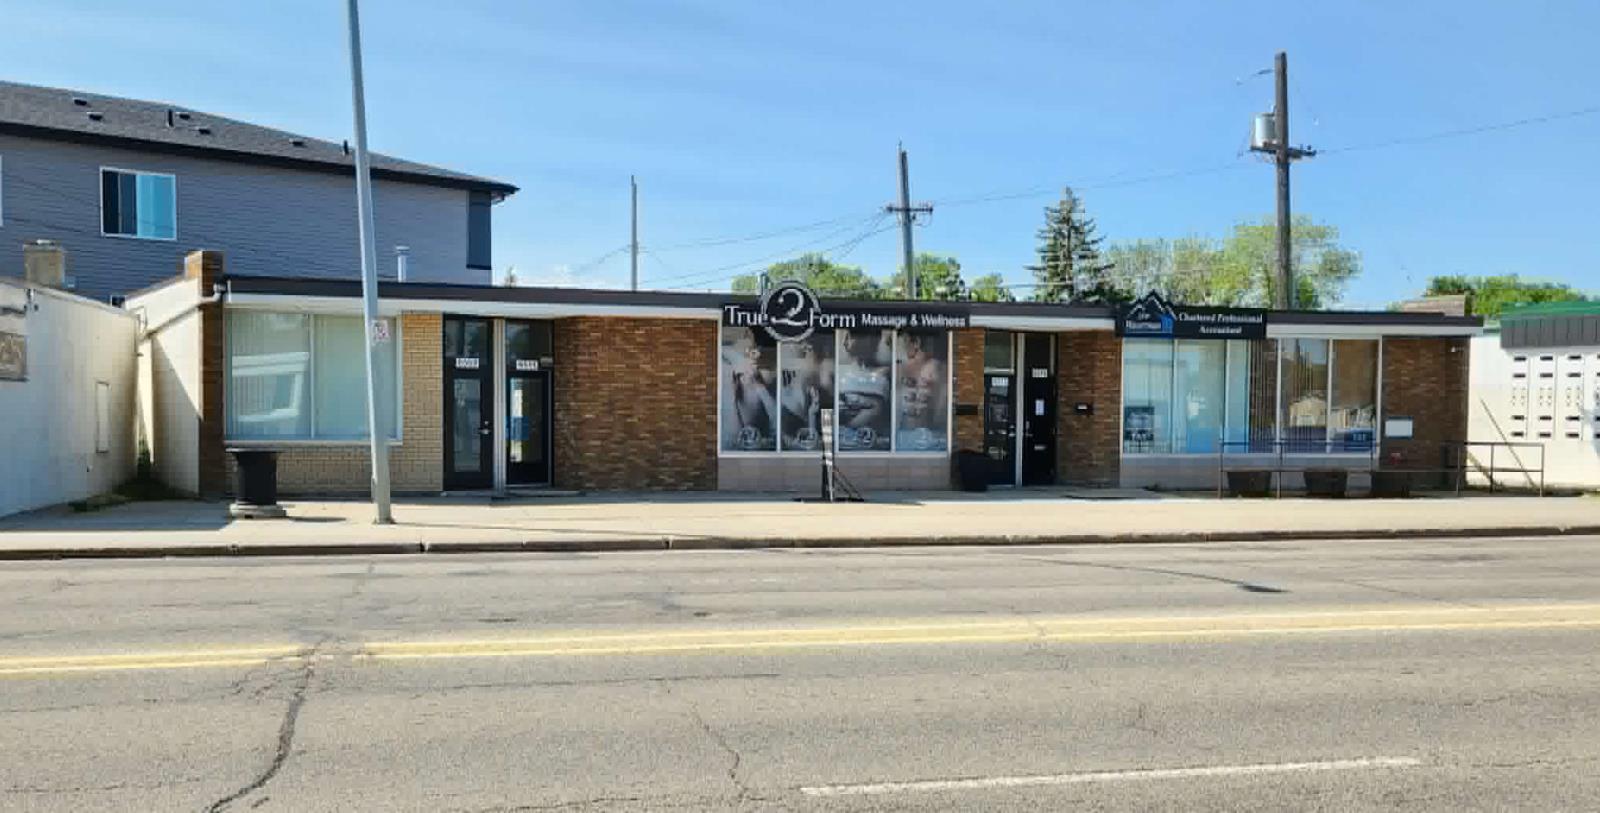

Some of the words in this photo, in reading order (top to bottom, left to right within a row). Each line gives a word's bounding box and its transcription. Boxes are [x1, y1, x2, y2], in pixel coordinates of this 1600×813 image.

[724, 304, 768, 326] True
[770, 287, 808, 326] 2
[809, 307, 857, 328] Form
[861, 312, 908, 327] Massage
[910, 312, 918, 327] &
[921, 313, 966, 327] Wellness
[1179, 312, 1217, 322] Chartered
[1217, 313, 1263, 324] Professional
